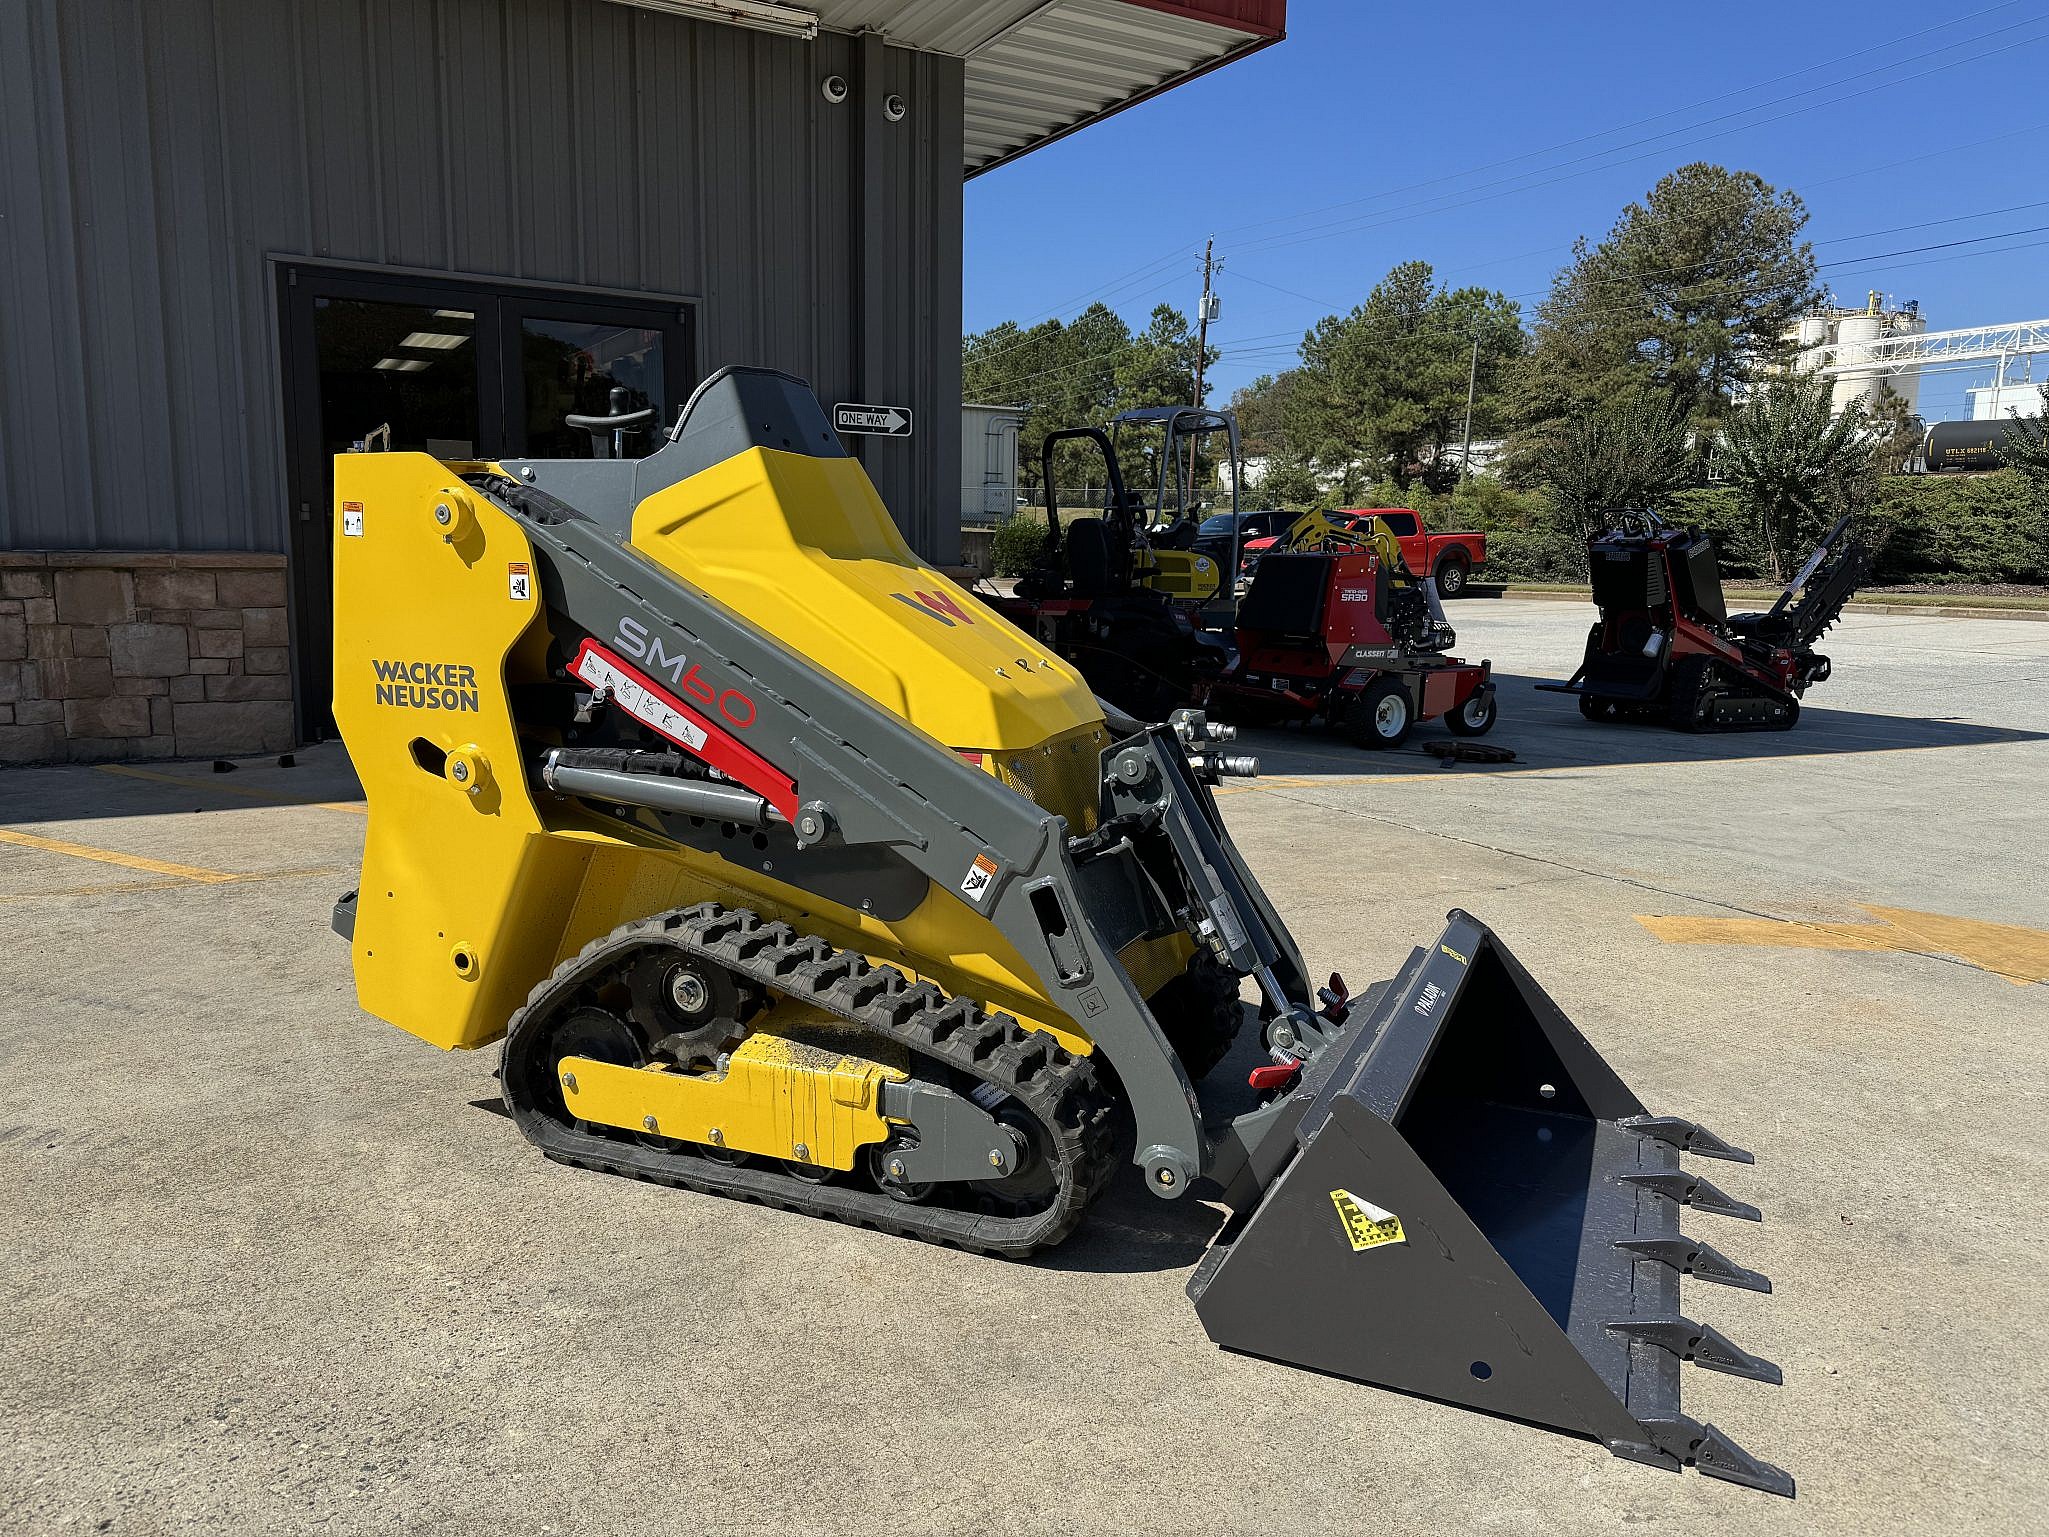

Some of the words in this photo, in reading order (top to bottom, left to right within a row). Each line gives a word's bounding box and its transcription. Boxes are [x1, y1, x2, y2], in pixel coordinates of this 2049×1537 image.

[841, 412, 863, 425] ONE
[866, 414, 888, 426] WAY
[1341, 594, 1368, 602] SA30
[371, 659, 478, 688] WACKER
[613, 616, 757, 729] SM60
[375, 683, 479, 713] NEUSON
[1417, 981, 1441, 1013] PALADIN
